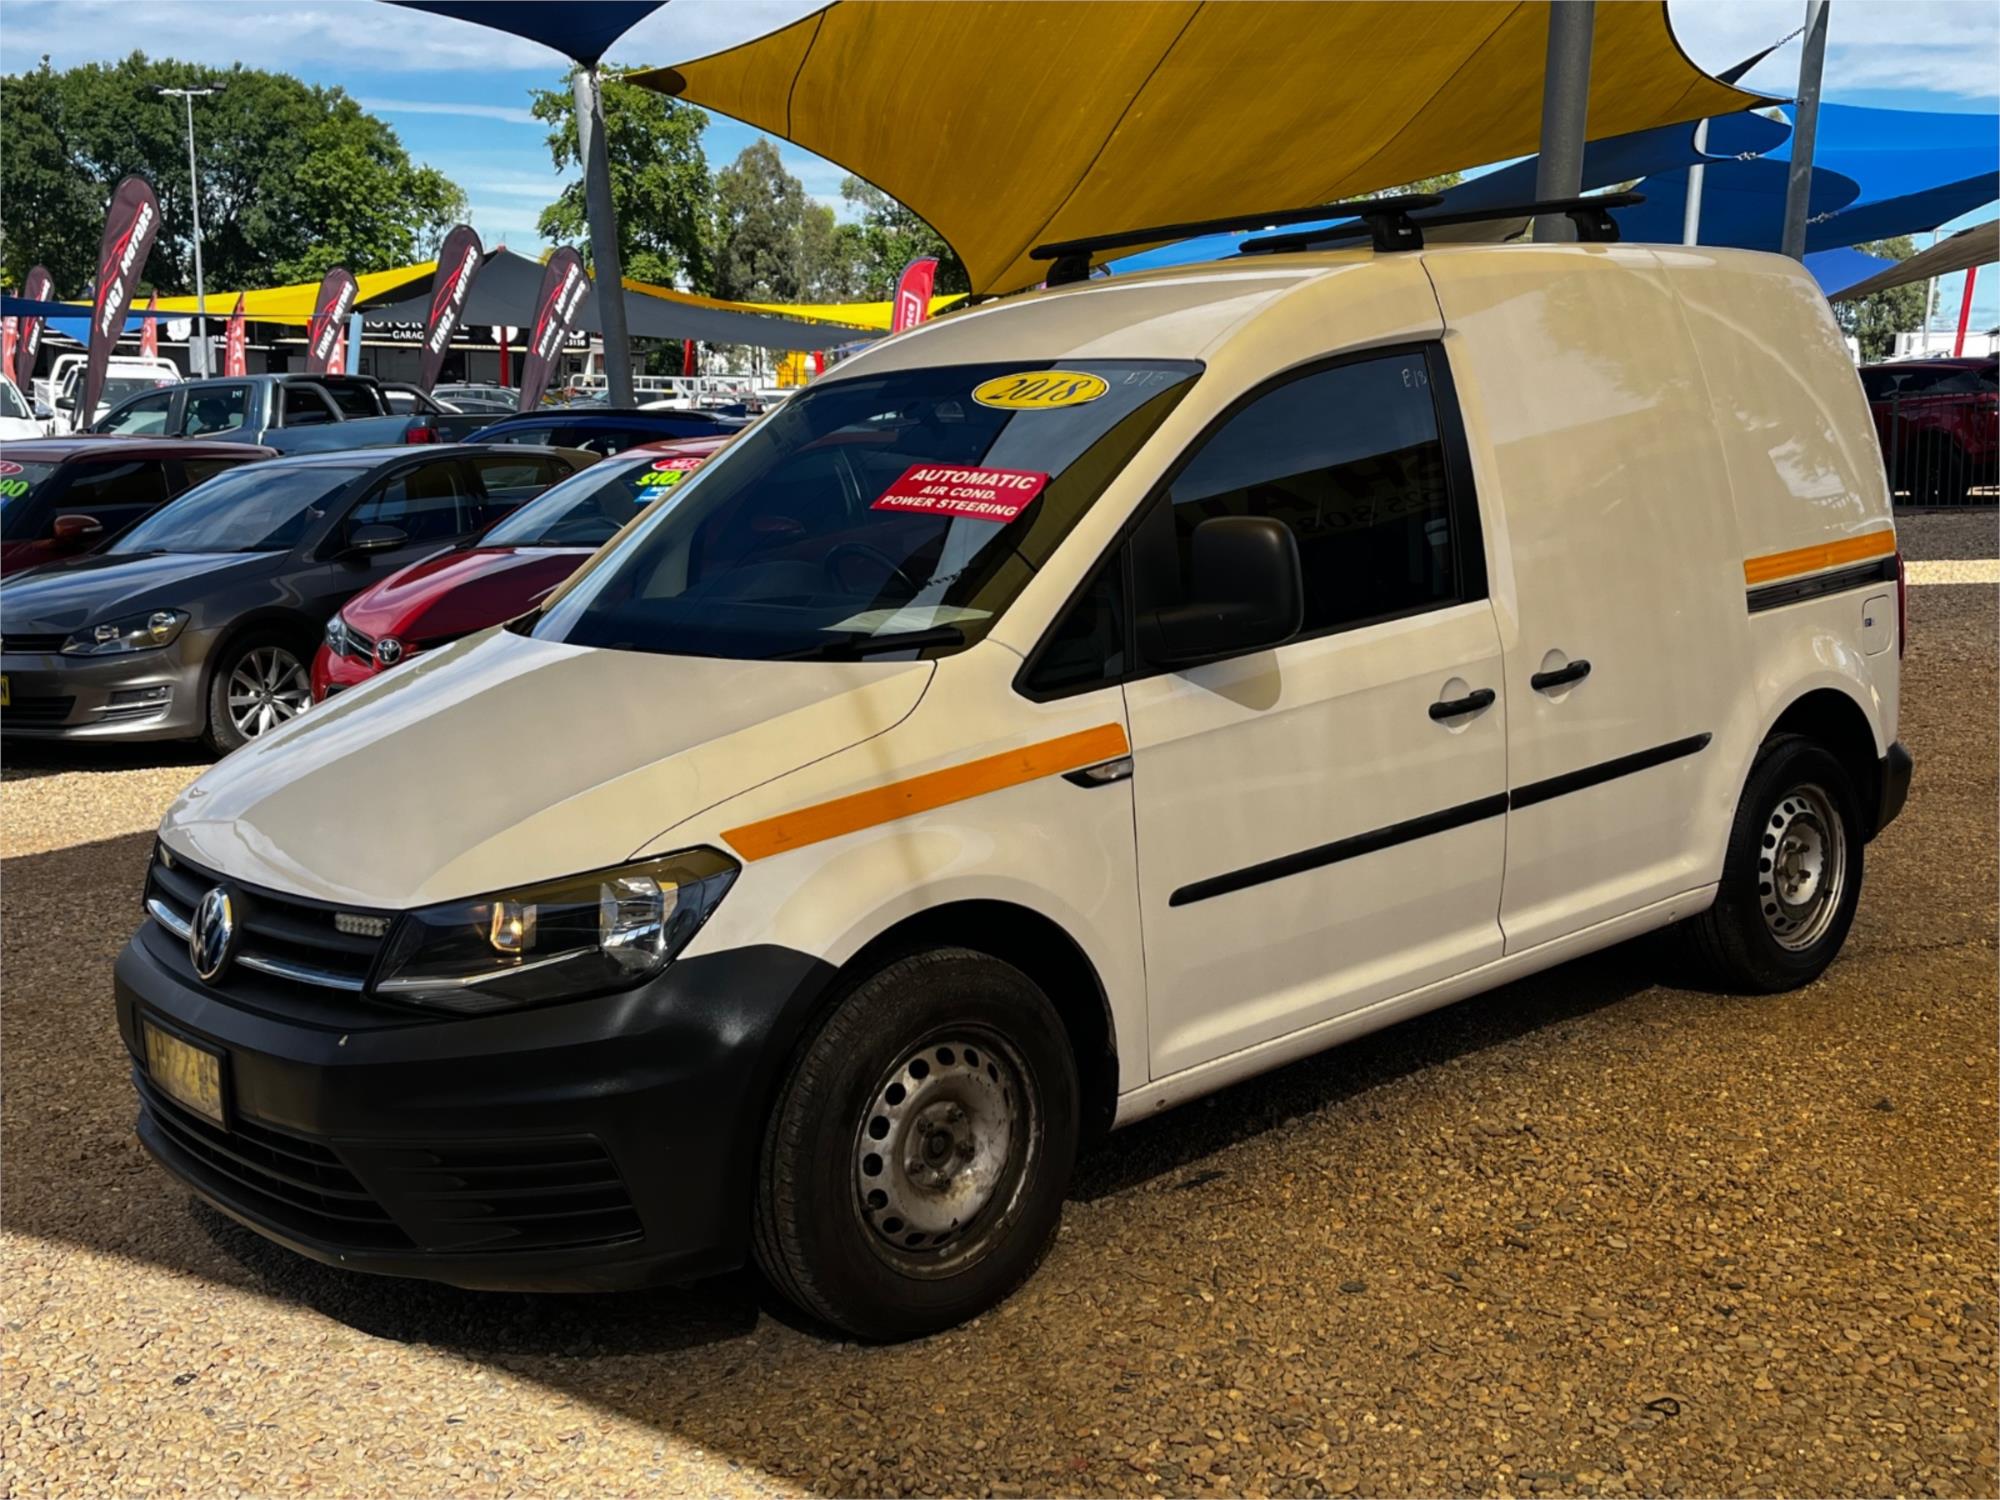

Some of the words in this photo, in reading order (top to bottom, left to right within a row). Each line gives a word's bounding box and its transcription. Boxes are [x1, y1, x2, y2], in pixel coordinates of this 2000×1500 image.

[120, 202, 153, 276] MOTORS
[429, 305, 455, 354] KINGZ
[453, 246, 478, 305] MOTORS
[392, 330, 425, 339] GARAG
[986, 378, 1092, 402] 2018
[910, 469, 1037, 490] AUTOMATIC
[919, 485, 949, 495] AIR
[950, 487, 997, 501] COND.
[881, 495, 934, 508] POWER
[936, 499, 1018, 517] STEERING
